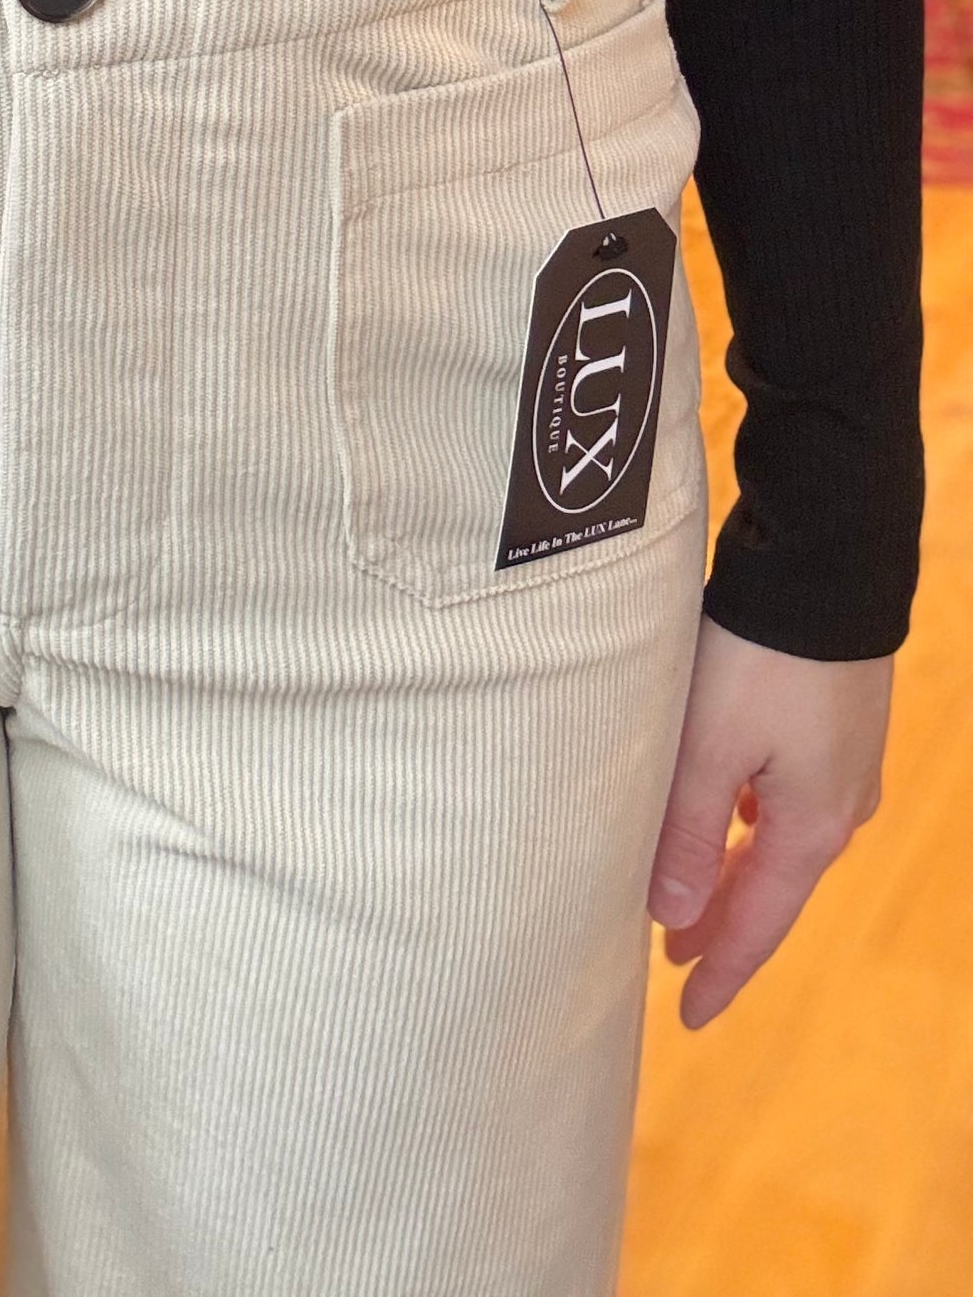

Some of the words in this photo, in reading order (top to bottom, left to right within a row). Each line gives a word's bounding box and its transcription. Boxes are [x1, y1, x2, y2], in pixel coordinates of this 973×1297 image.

[548, 354, 568, 453] BOUTIQUE
[560, 289, 632, 495] LUX
[508, 548, 530, 560] Live
[531, 540, 550, 554] Life
[552, 537, 563, 548] In
[565, 532, 583, 543] The
[584, 522, 607, 537] LUX
